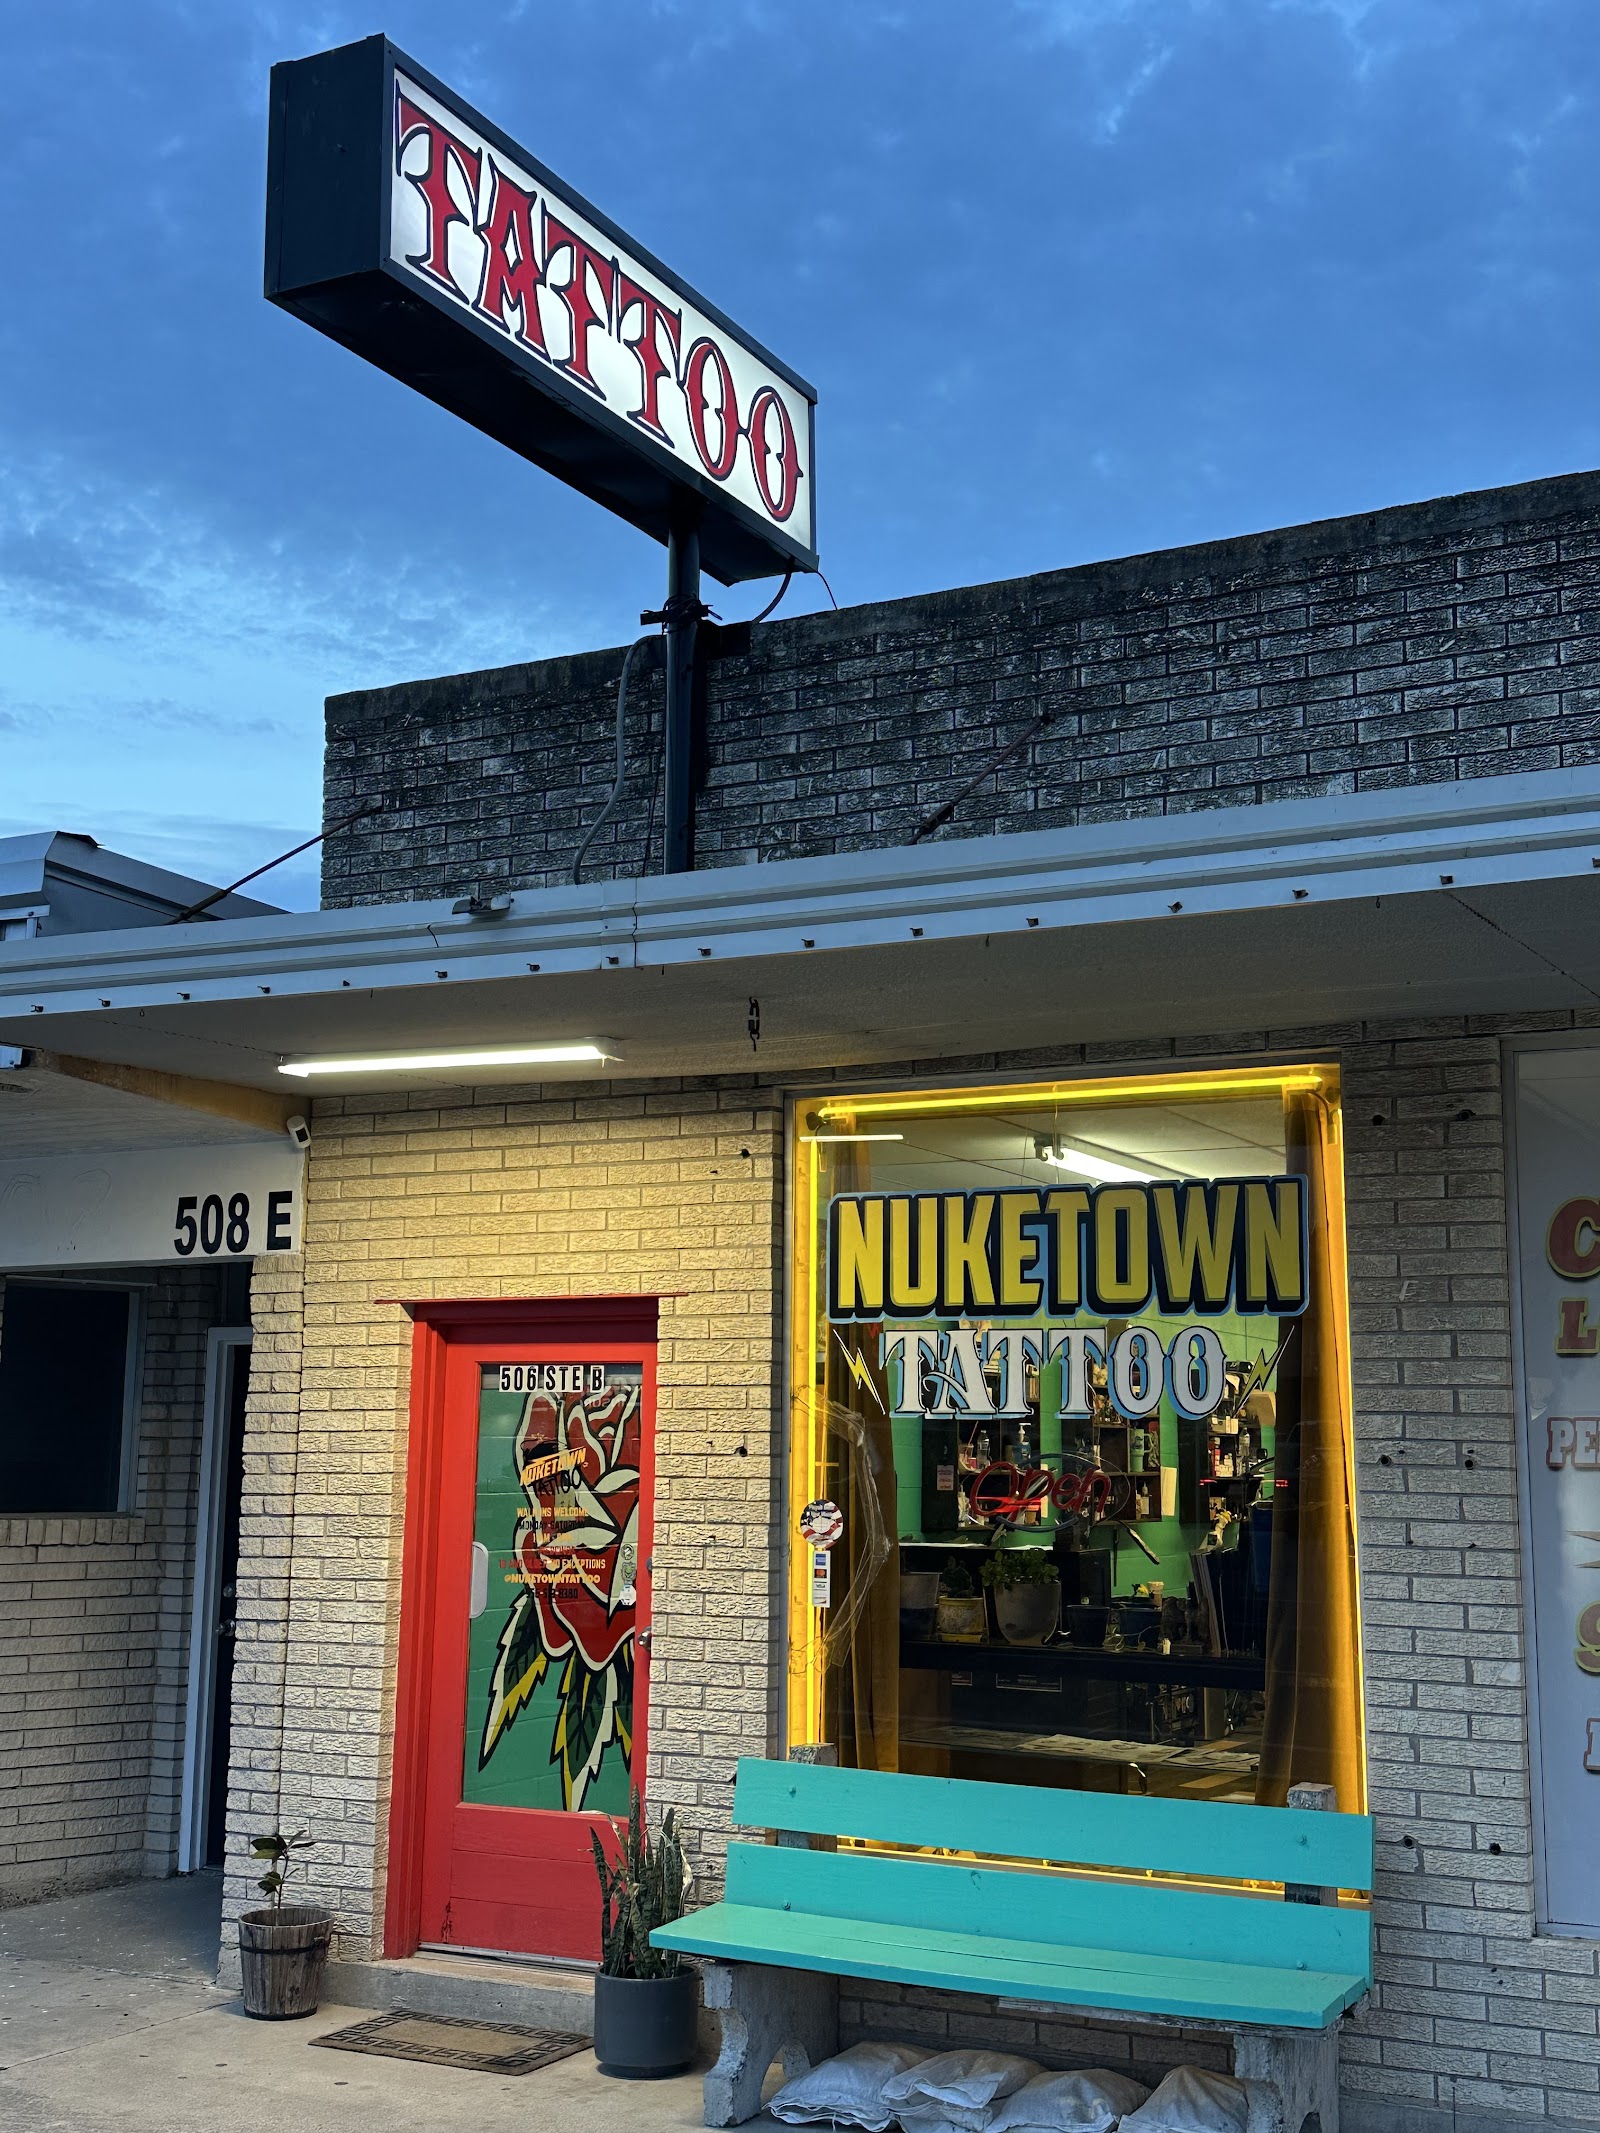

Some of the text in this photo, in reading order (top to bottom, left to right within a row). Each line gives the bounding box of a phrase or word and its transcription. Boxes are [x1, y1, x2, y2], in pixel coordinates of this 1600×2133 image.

[395, 79, 803, 523] TATTOO
[174, 1191, 293, 1256] 508 E
[828, 1176, 1309, 1323] NUKETOWN
[501, 1366, 603, 1391] 506 STE B
[879, 1325, 1227, 1419] TATTOO
[1546, 1416, 1600, 1470] PE
[970, 1461, 1112, 1523] Open
